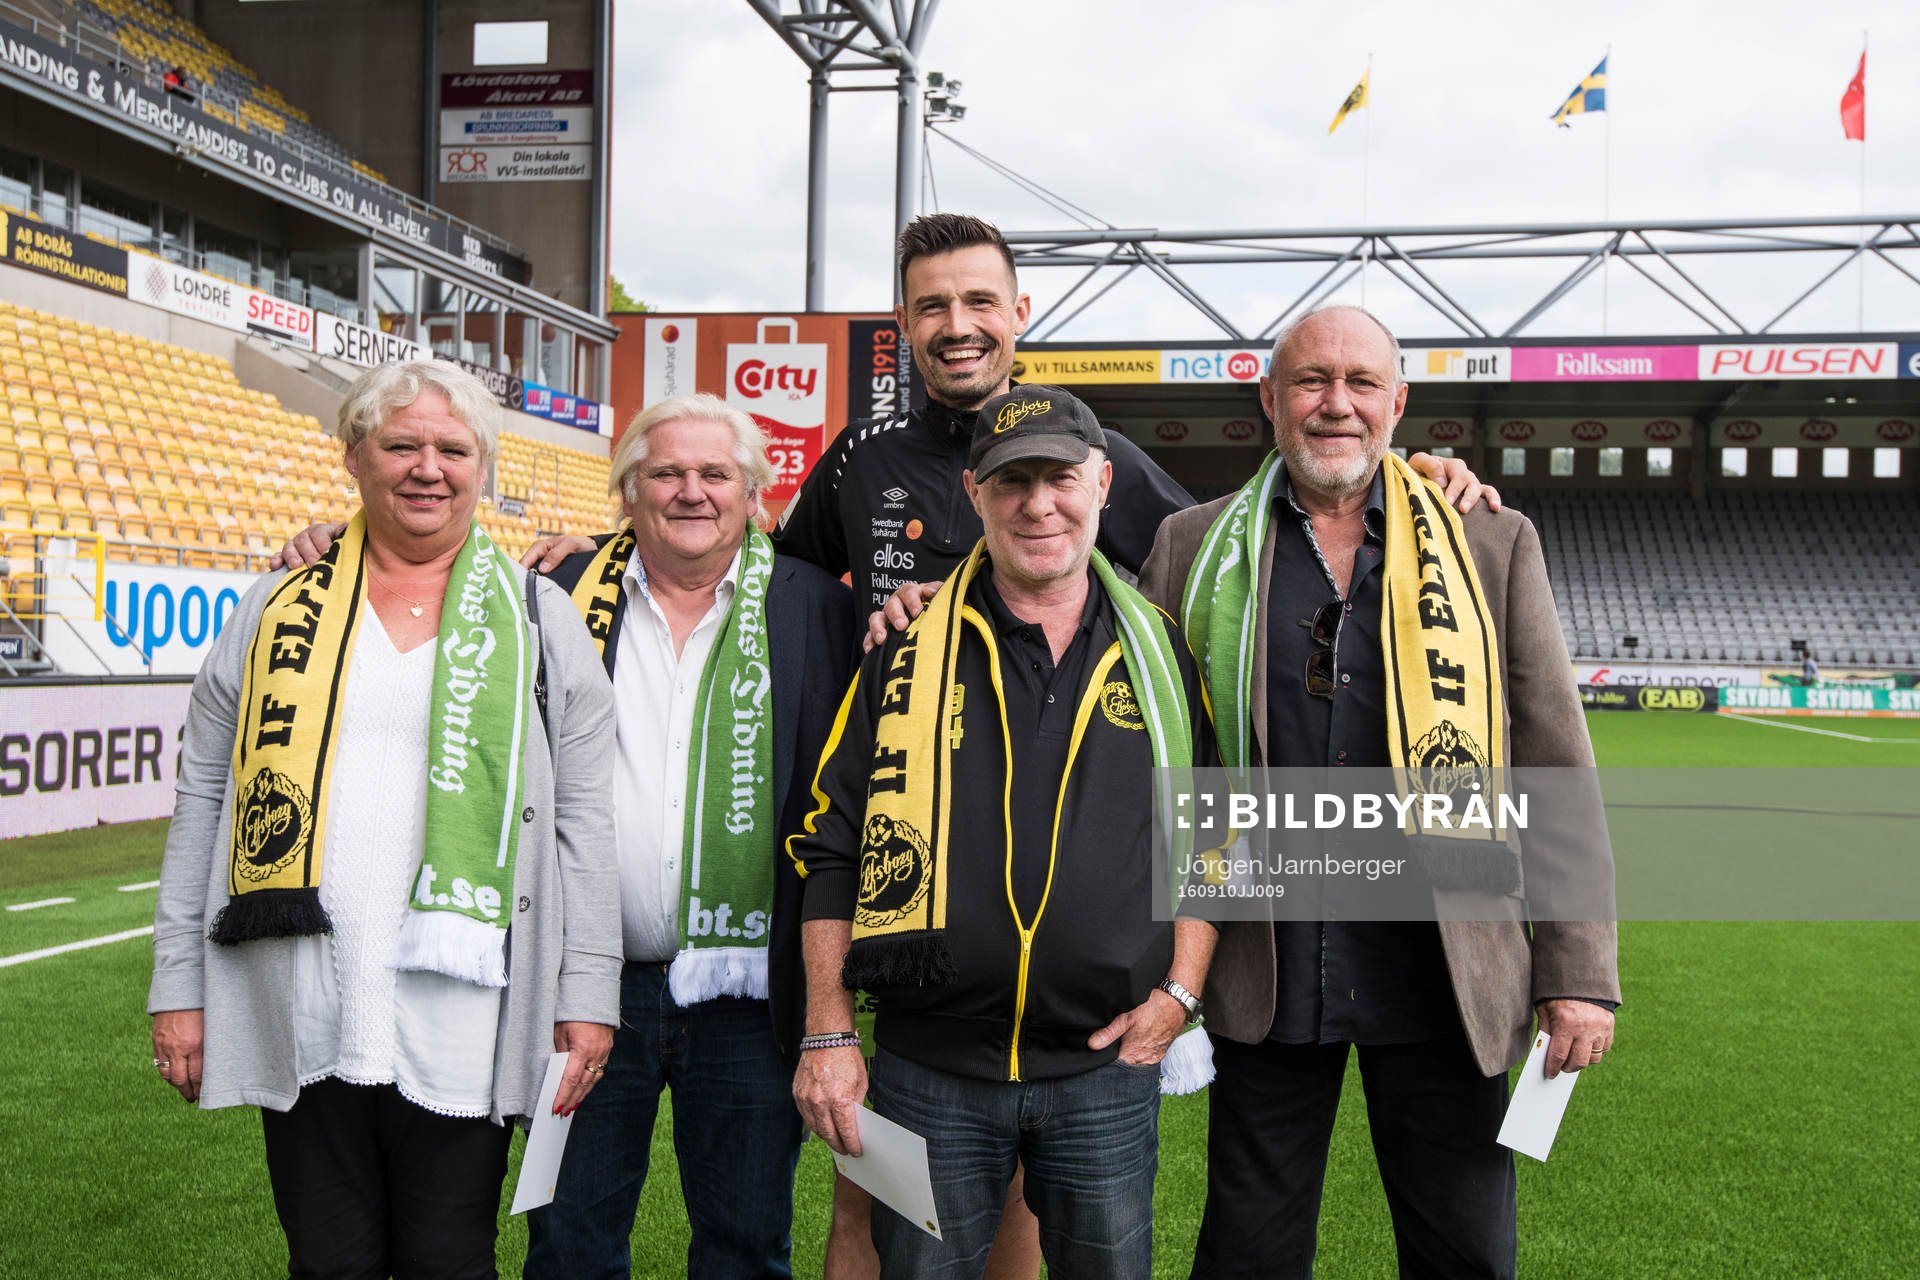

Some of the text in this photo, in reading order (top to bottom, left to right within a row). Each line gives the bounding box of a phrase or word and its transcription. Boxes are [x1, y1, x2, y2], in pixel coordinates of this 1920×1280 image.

[551, 89, 583, 100] AB
[87, 69, 105, 104] &
[254, 150, 276, 177] TO
[333, 186, 355, 211] ON
[358, 201, 383, 225] ALL
[513, 151, 570, 162] Din lokala
[15, 226, 73, 258] AB BORÅS
[14, 248, 127, 294] RÖRINSTALLATIONER
[173, 272, 231, 308] LONDRÉ
[247, 294, 310, 333] SPEED
[1034, 360, 1155, 375] VI TILLSAMMANS
[1170, 351, 1223, 379] net
[1232, 360, 1255, 374] on
[1555, 351, 1653, 376] Folksam
[1711, 348, 1885, 375] PULSEN
[735, 359, 817, 399] City
[871, 518, 904, 528] Swedbank
[871, 528, 898, 538] Sjuhärad
[873, 543, 915, 570] ellos
[725, 533, 773, 835] Borås Tidning
[1425, 649, 1466, 707] IF
[429, 626, 497, 795] Tidning
[1646, 688, 1699, 708] EAB
[1726, 687, 1792, 707] SKYDDA
[1806, 688, 1874, 709] SKYDDA
[256, 693, 297, 750] IF
[0, 725, 163, 796] SORER
[868, 742, 907, 799] IF
[688, 896, 772, 940] bt.s
